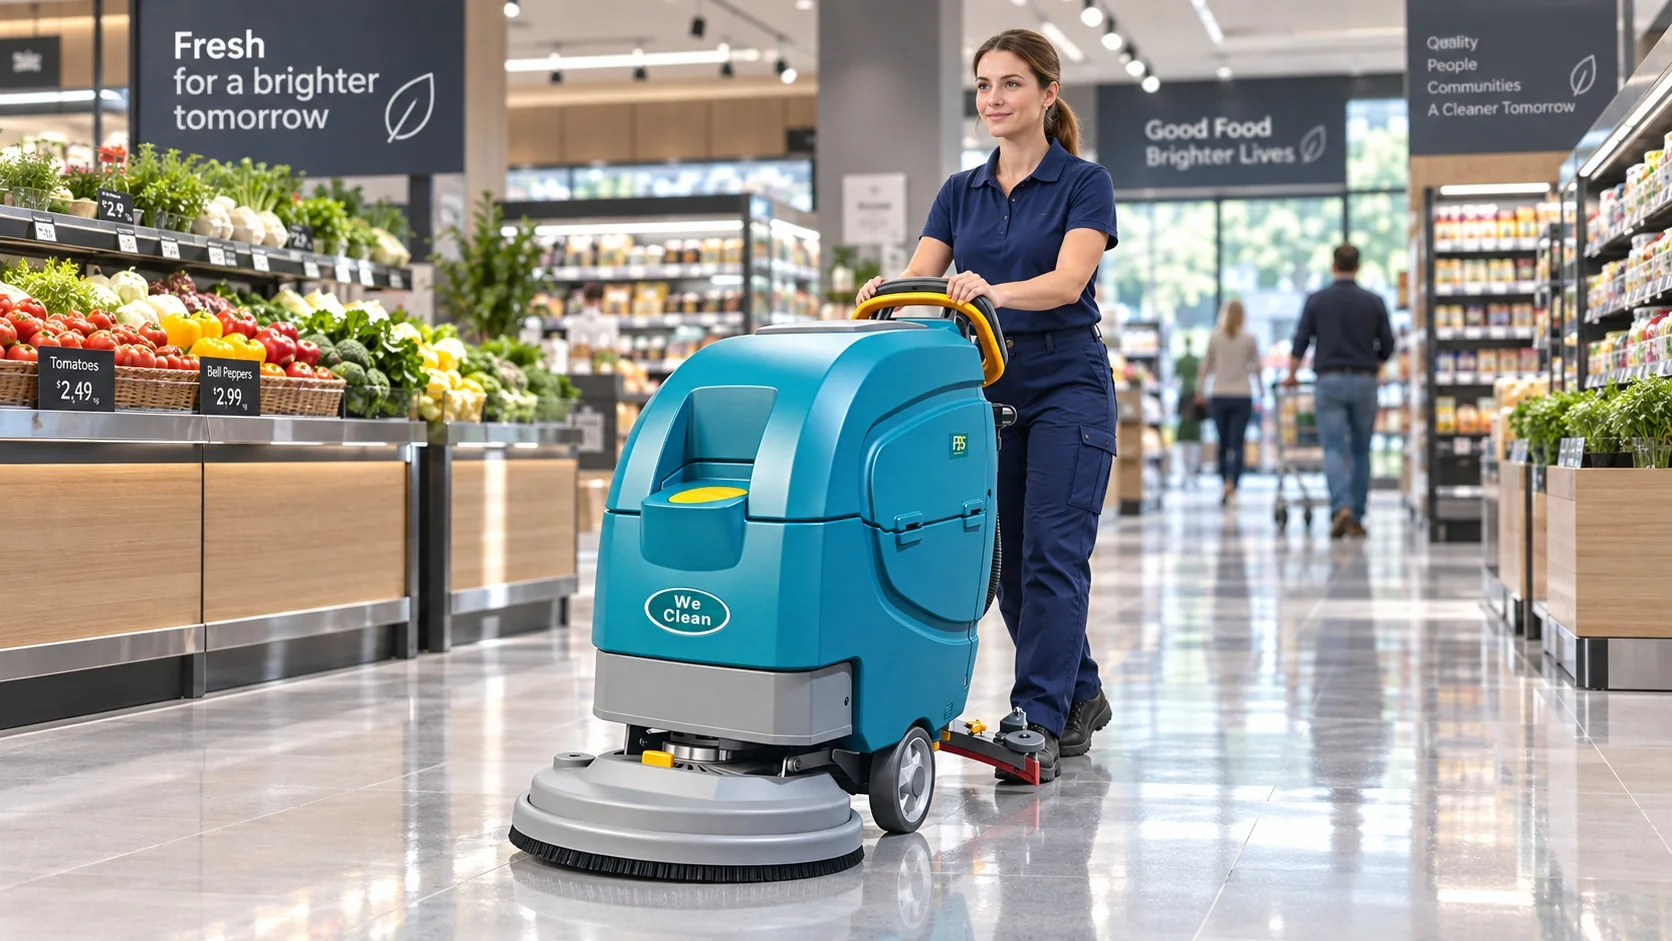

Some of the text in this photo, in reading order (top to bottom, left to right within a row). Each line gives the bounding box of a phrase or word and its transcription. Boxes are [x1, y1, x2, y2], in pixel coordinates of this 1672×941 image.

[174, 29, 265, 59] Fresh
[1427, 35, 1478, 52] Quality
[1427, 58, 1478, 74] People
[174, 66, 380, 101] for a brighter
[1427, 79, 1522, 94] Communities
[1428, 100, 1576, 117] A Cleaner Tomorrow
[174, 105, 330, 130] tomorrow
[1145, 116, 1272, 140] Good Food
[1146, 144, 1295, 170] Brighter Lives
[50, 356, 99, 371] Tomatoes
[207, 365, 253, 381] Bell Peppers
[674, 594, 701, 610] We
[663, 608, 711, 626] Clean
